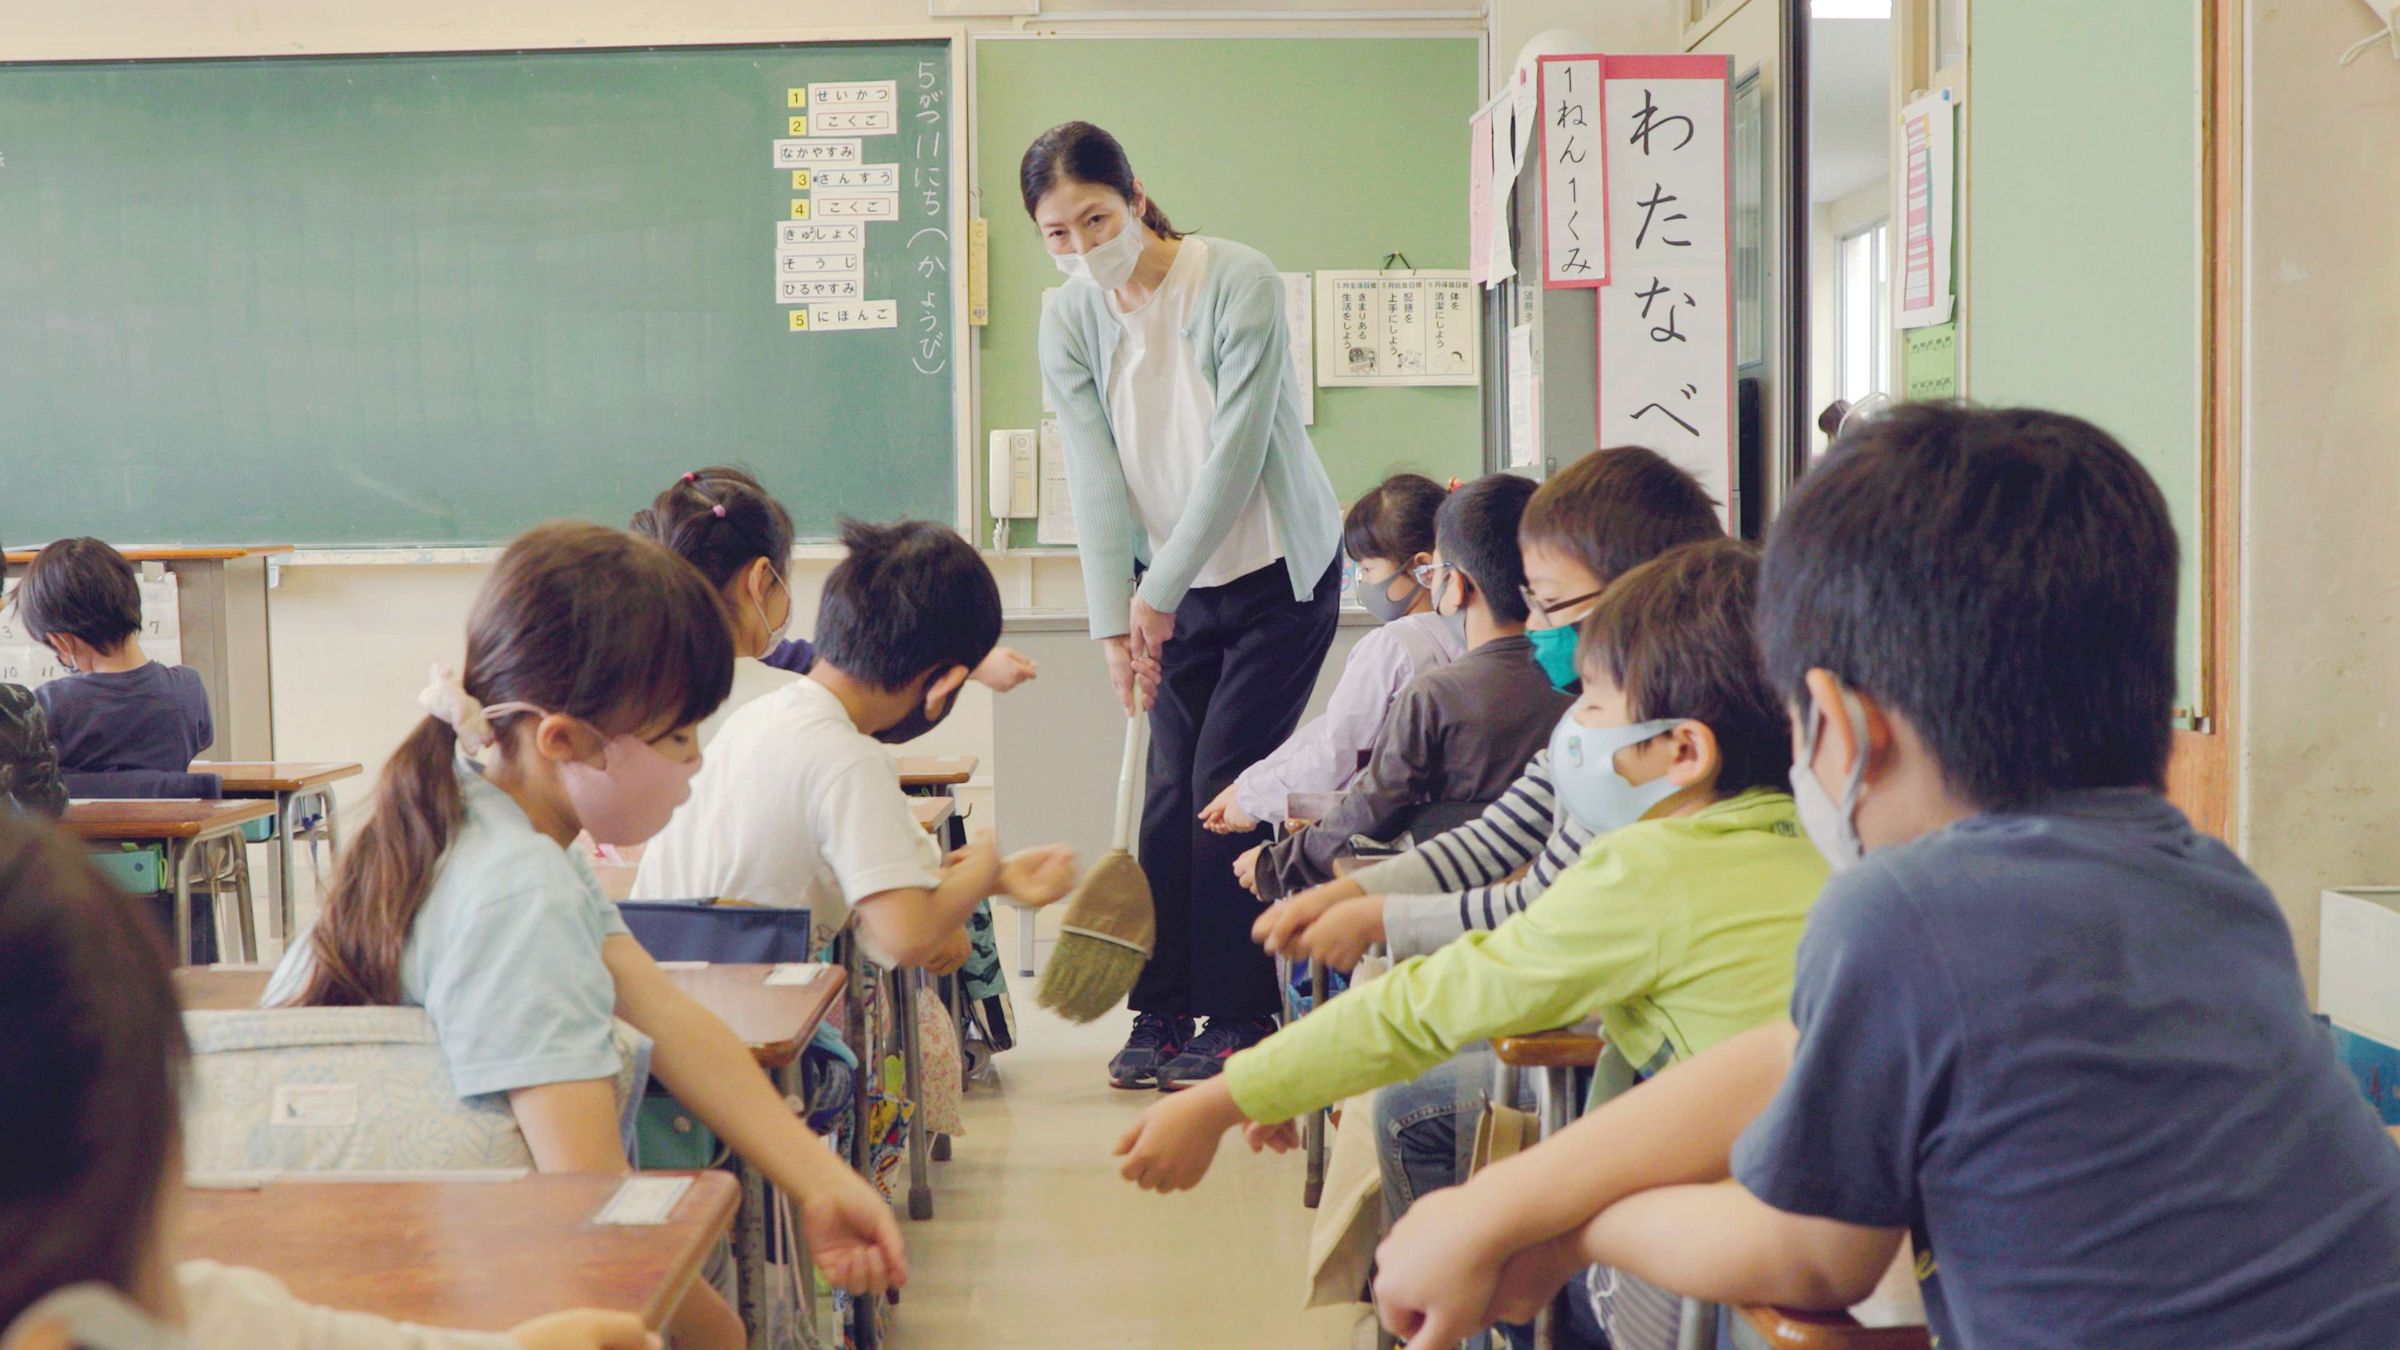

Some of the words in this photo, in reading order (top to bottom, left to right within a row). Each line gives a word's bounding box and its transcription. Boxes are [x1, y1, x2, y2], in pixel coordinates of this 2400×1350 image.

[792, 92, 800, 104] 1
[816, 88, 889, 103] せいかつ
[792, 121, 802, 132] 2
[828, 112, 878, 127] こくご
[782, 145, 853, 159] なかやすみ
[1556, 66, 1591, 274] 1ねん1くみ
[798, 174, 808, 186] 3
[818, 171, 890, 184] さんすう
[795, 204, 804, 215] 4
[829, 200, 878, 213] こくご
[783, 257, 856, 270] そうじ
[1629, 88, 1700, 437] わたなべ
[784, 282, 856, 296] ひるやすみ
[795, 315, 804, 327] 5
[817, 308, 889, 322] にほんご
[1358, 292, 1368, 340] きまりある
[1388, 293, 1399, 356] 上手にしよう
[1, 625, 13, 639] 3
[149, 620, 160, 635] 7
[3, 666, 18, 679] 10
[41, 666, 54, 677] 11
